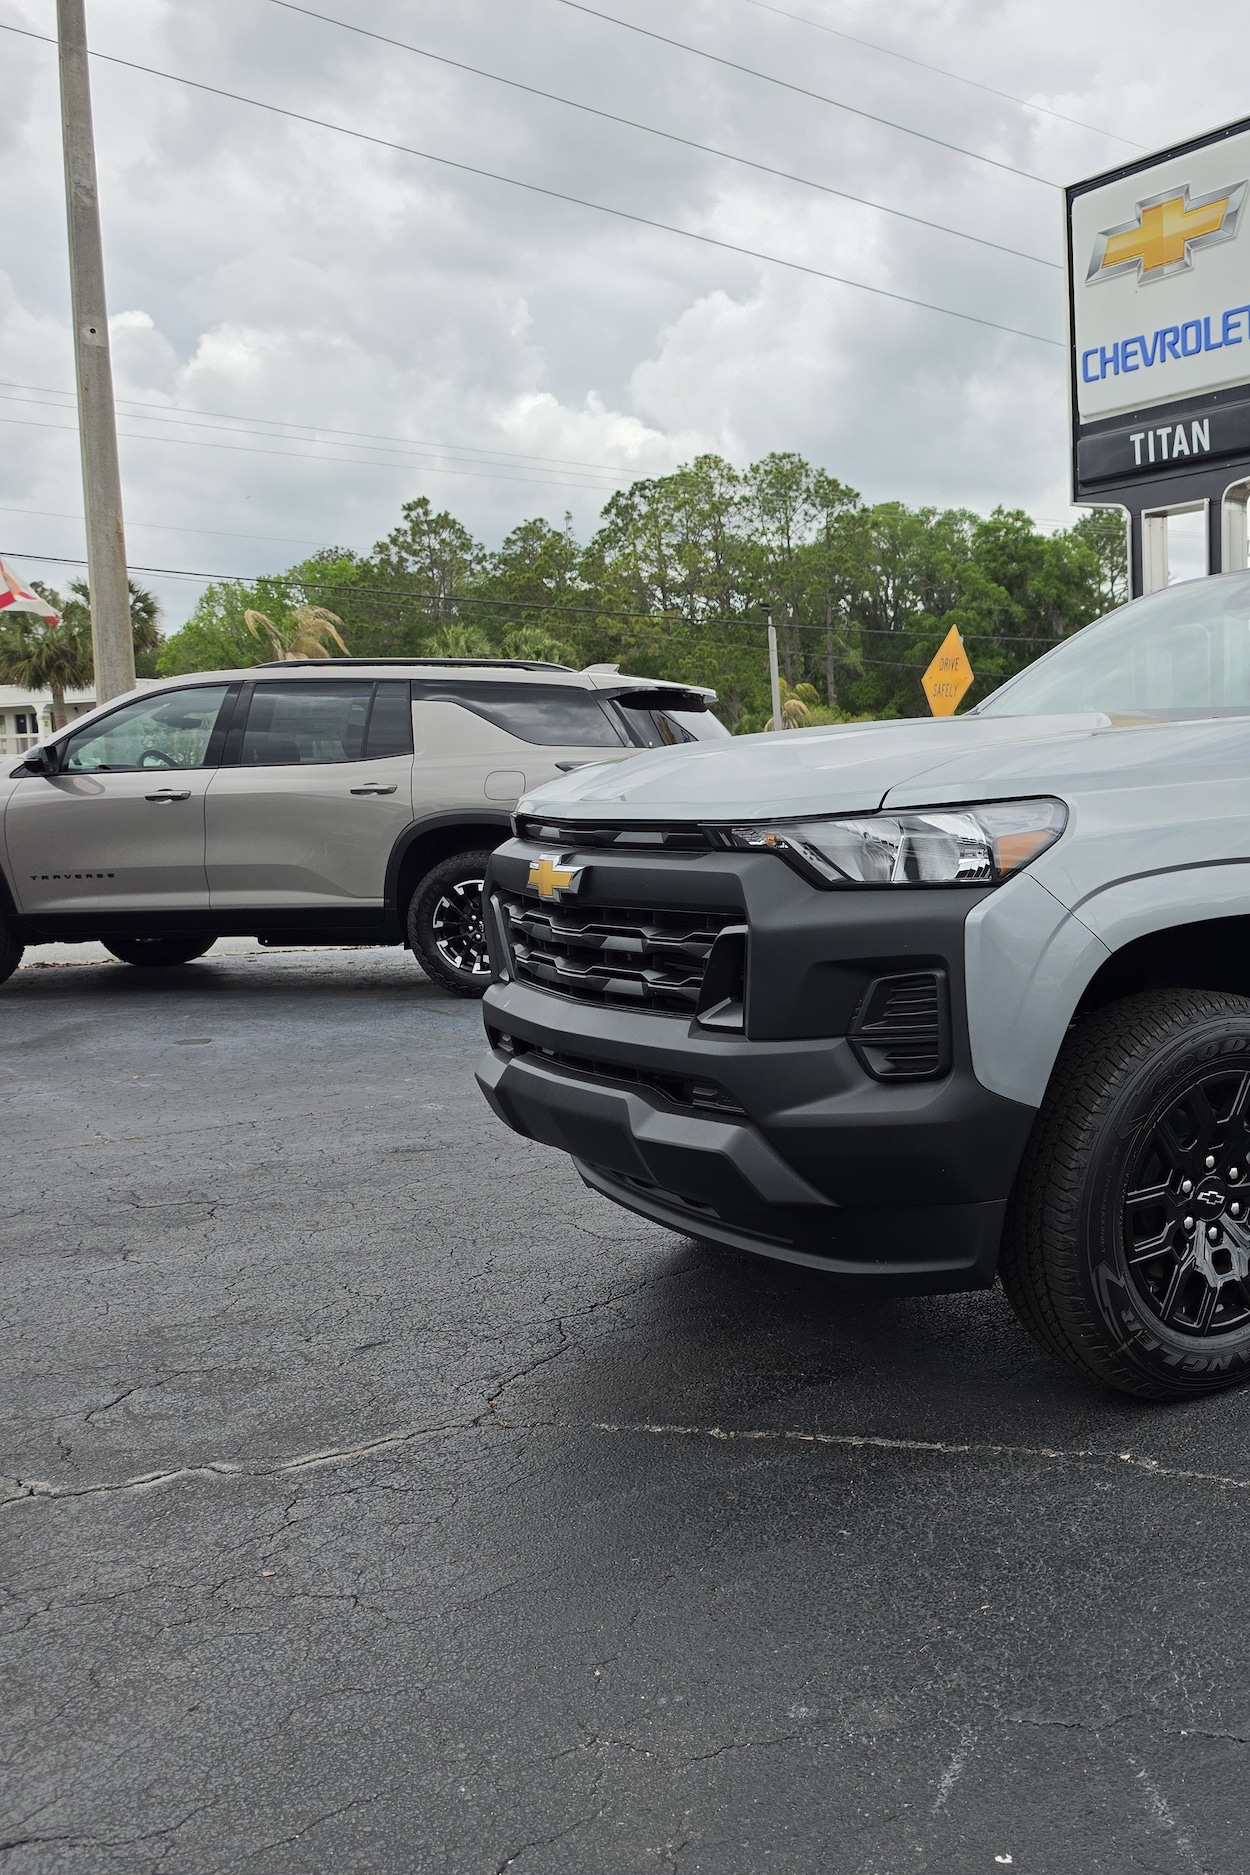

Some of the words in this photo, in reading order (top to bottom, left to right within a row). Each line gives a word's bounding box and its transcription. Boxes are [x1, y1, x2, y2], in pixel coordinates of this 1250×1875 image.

[1129, 418, 1211, 466] TITAN
[939, 657, 960, 671] DRIVE
[933, 683, 959, 697] SAFELY
[29, 872, 116, 881] TRAVERSE
